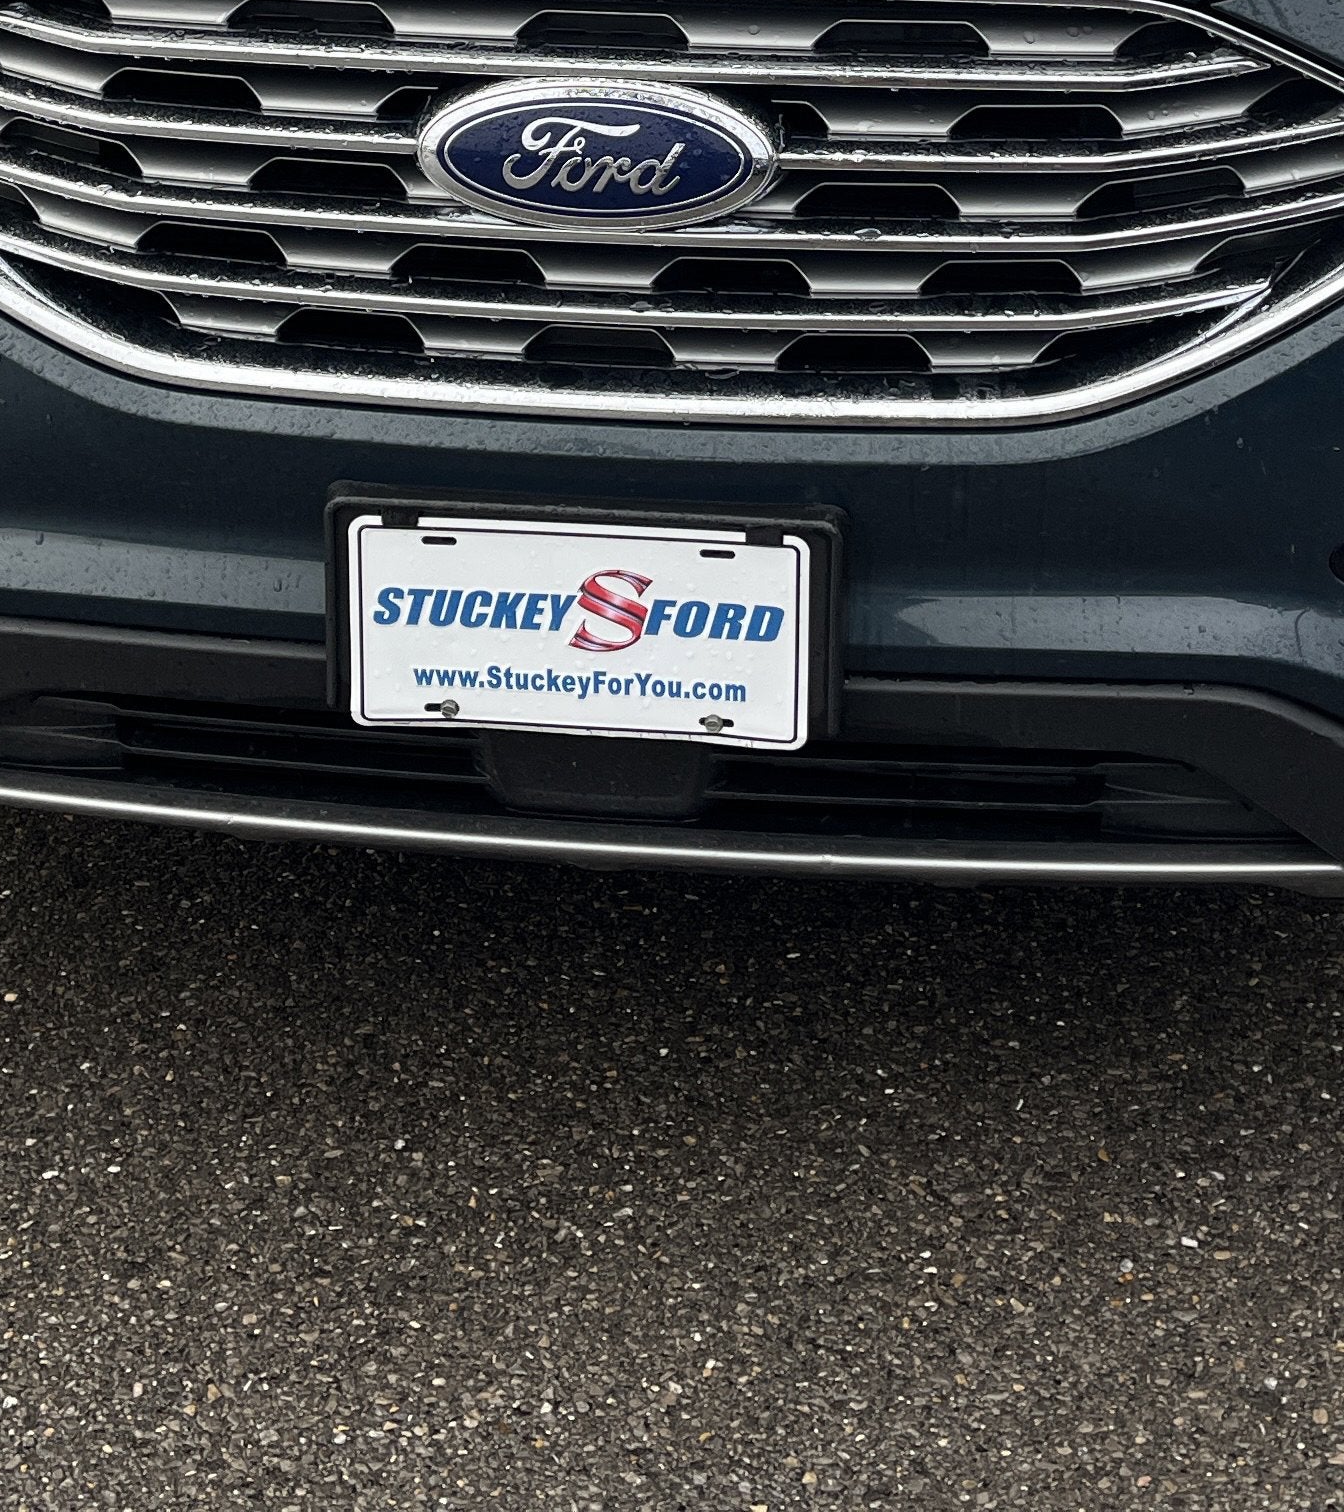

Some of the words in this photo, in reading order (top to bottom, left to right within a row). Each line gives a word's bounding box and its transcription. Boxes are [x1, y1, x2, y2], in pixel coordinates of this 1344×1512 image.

[501, 116, 687, 196] Ford
[373, 586, 578, 631] STUCKEY
[644, 599, 785, 642] FORD
[413, 664, 747, 702] www.StuckeyForYou.com
